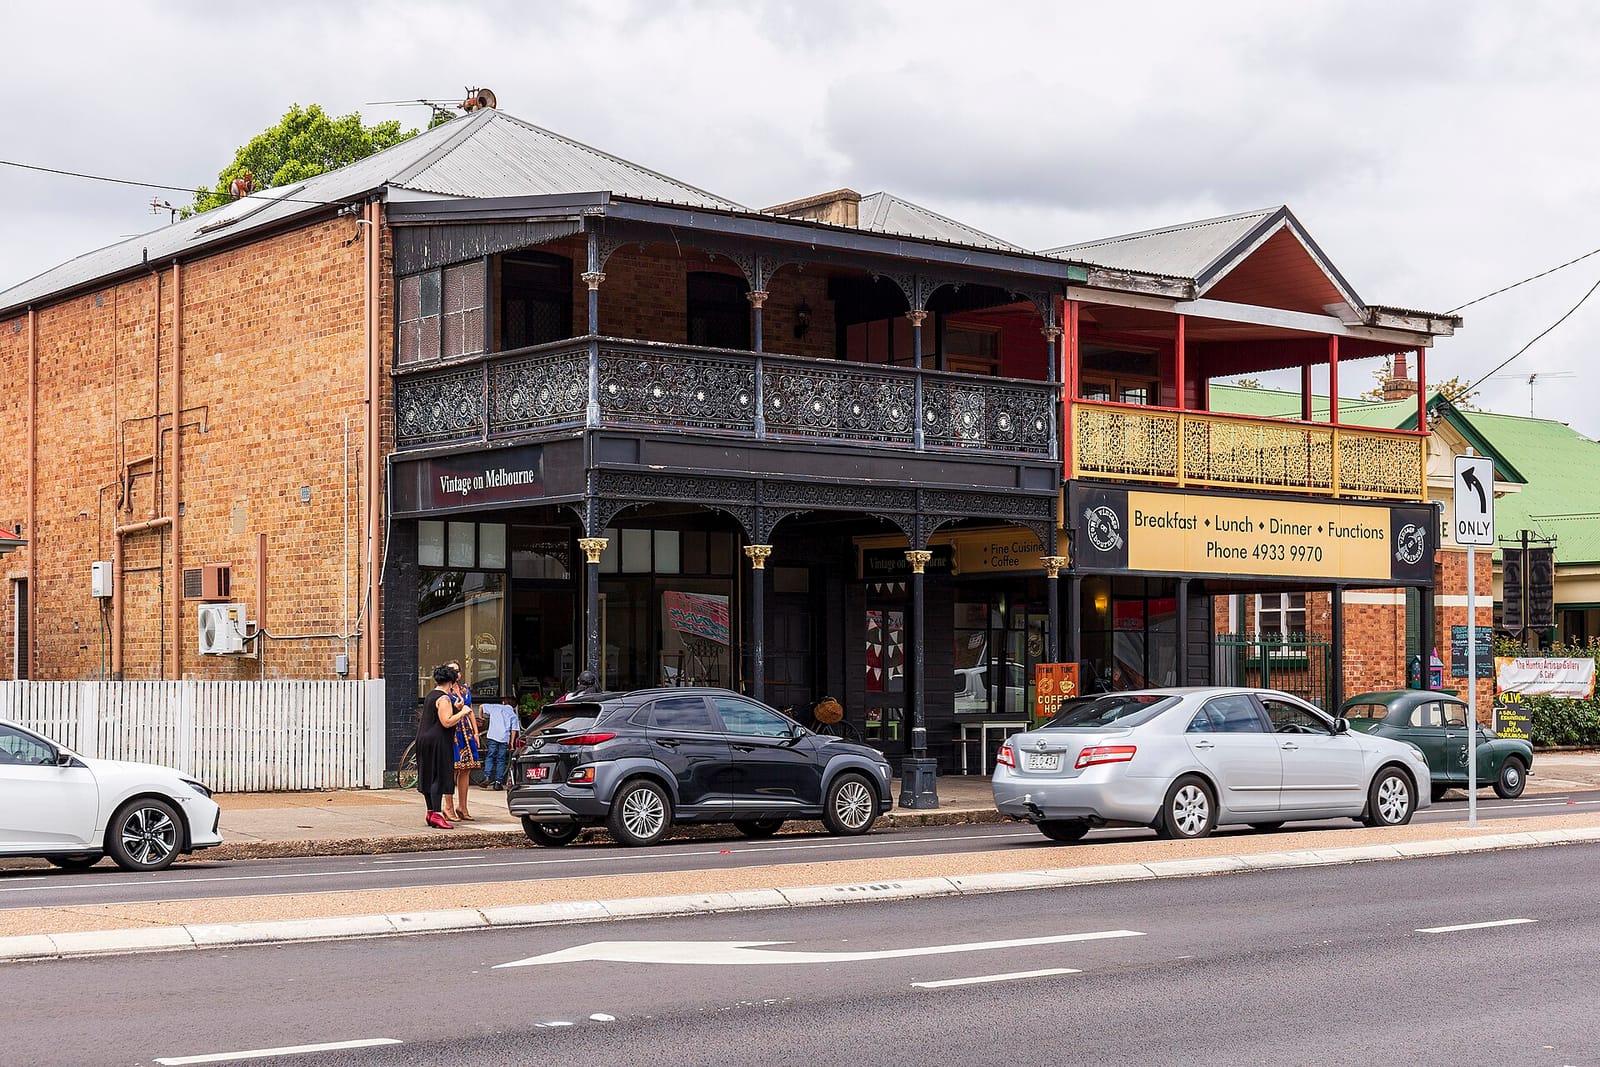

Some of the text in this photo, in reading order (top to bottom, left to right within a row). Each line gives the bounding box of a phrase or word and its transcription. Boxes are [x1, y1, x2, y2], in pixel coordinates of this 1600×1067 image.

[440, 468, 535, 496] Vintage on Melbourne
[1134, 509, 1384, 540] Breakfast Lunch Dinner Functions
[1458, 520, 1491, 536] ONLY
[991, 541, 1044, 554] Fine Cuisine
[1206, 541, 1323, 562] Phone 4933 9970
[870, 557, 896, 572] Vintage
[991, 554, 1020, 567] Coffee
[1515, 659, 1580, 671] The Hunter Artisan Gallery
[1501, 692, 1525, 704] ALIVE
